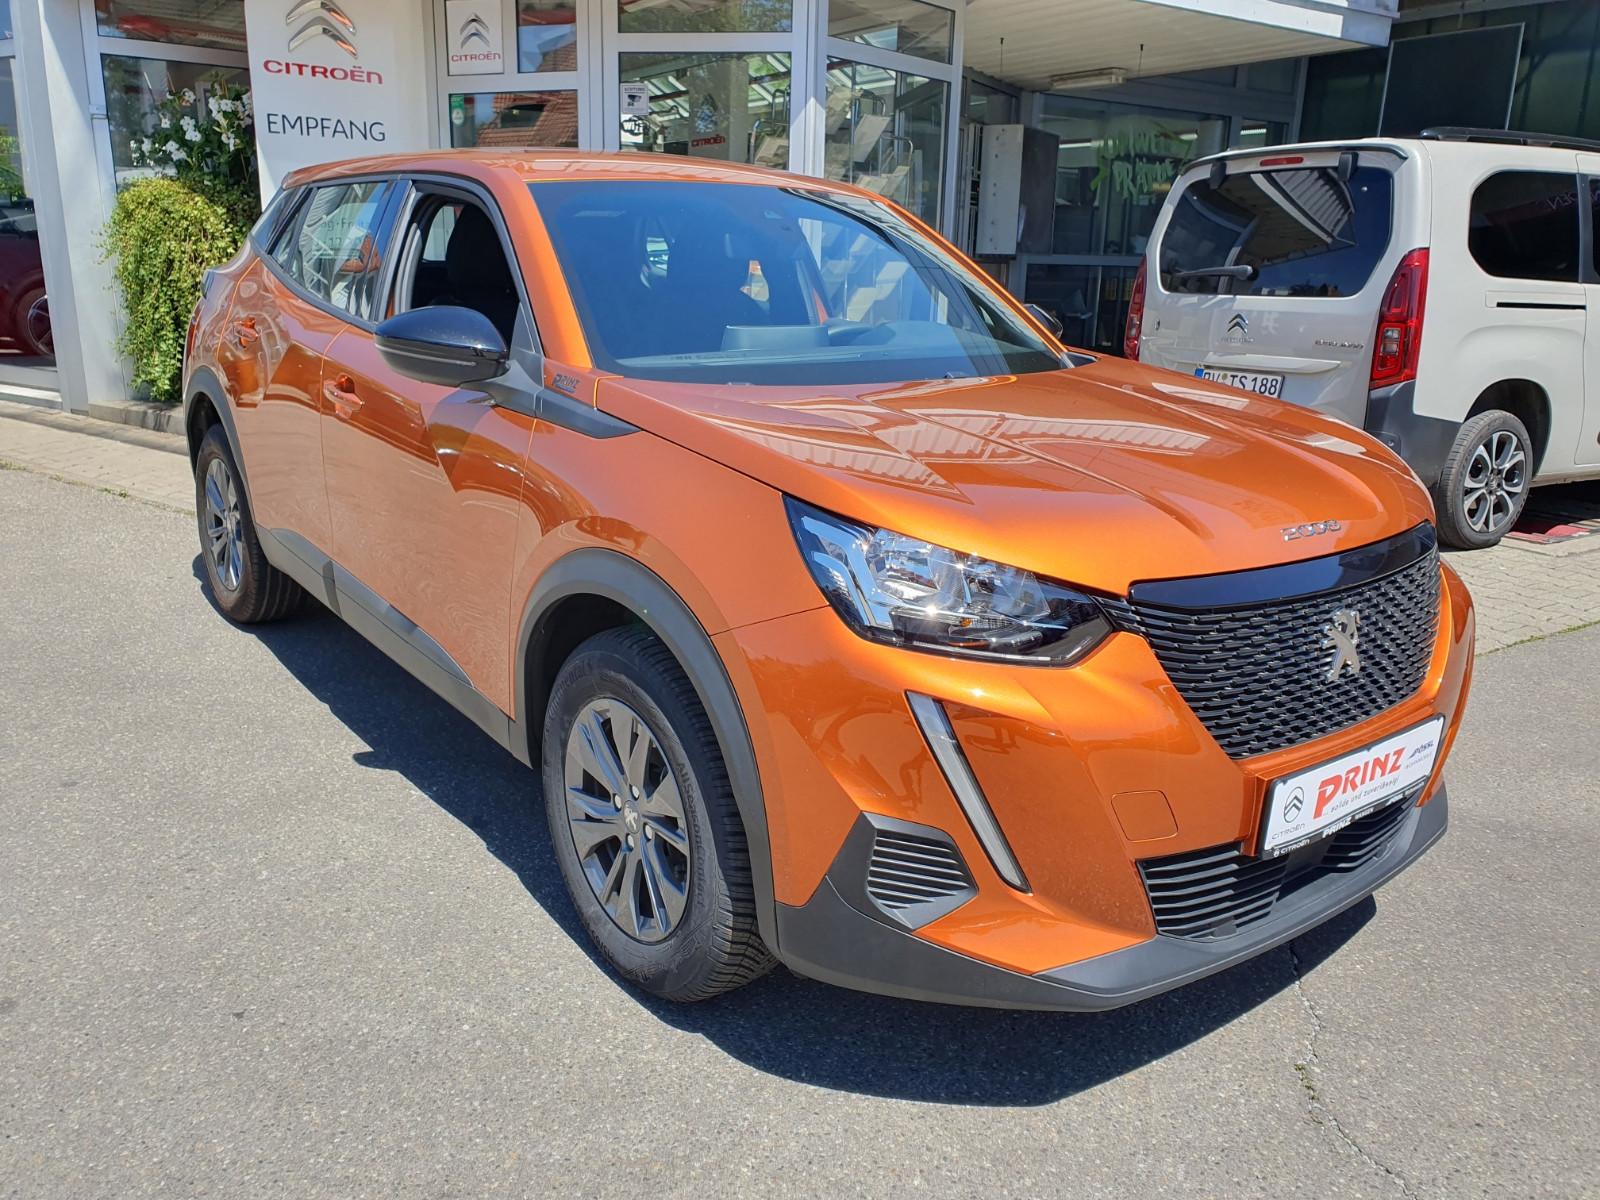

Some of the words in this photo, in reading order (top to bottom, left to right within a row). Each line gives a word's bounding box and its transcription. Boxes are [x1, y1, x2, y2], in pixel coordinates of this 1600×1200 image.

[450, 51, 502, 62] CITROËN
[263, 59, 383, 84] CITROËN
[266, 113, 386, 142] EMPFANG
[691, 134, 726, 147] CITROËN
[1230, 375, 1247, 390] TS
[1251, 377, 1279, 396] 188
[1280, 519, 1341, 541] 2008
[1313, 747, 1405, 820] PRINZ
[1271, 823, 1306, 840] CITROËN
[1322, 817, 1352, 838] PRINZ
